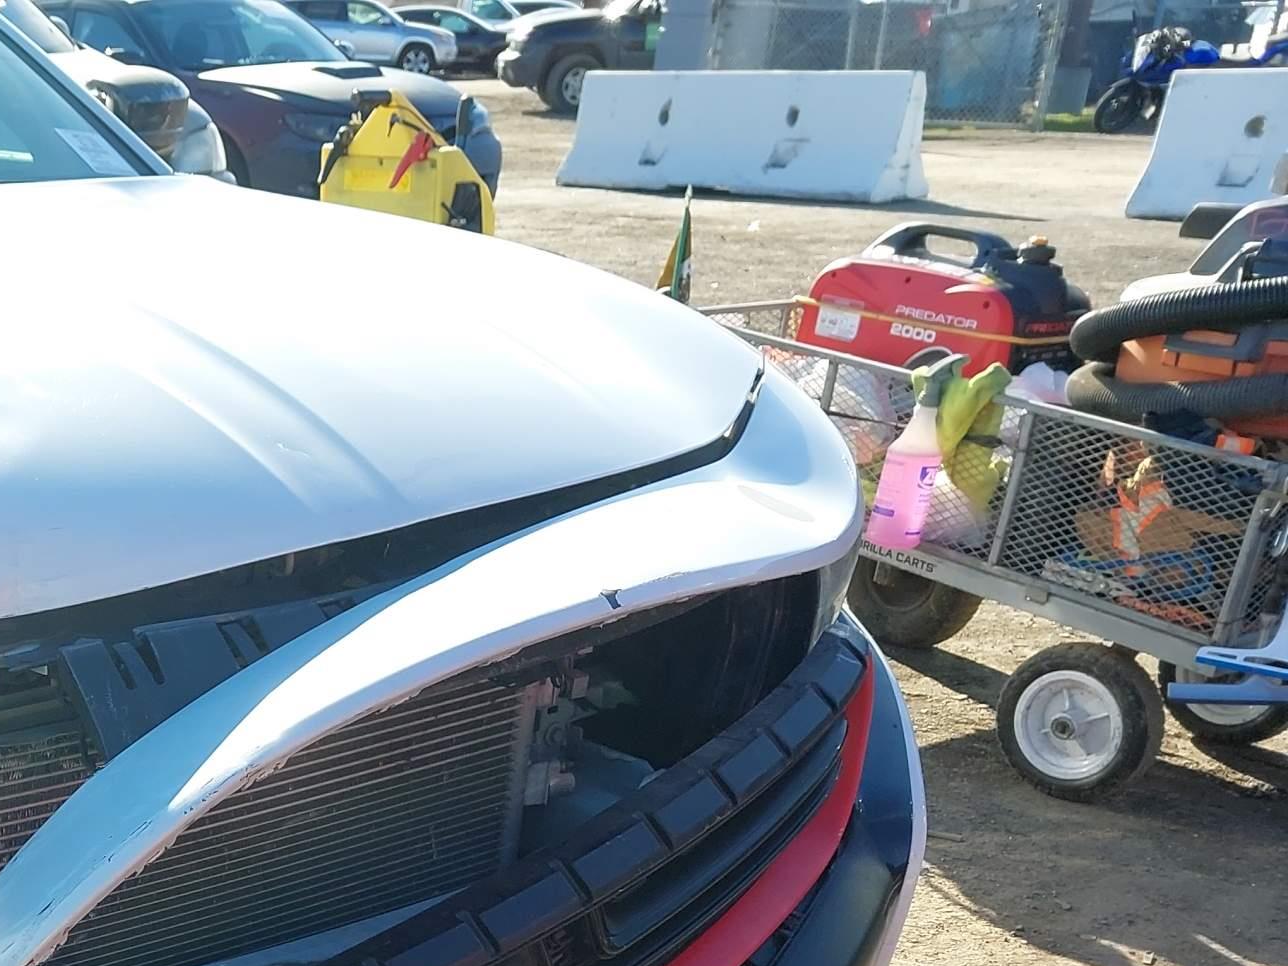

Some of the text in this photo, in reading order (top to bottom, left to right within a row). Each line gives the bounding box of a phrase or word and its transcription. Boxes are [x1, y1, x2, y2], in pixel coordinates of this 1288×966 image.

[895, 304, 978, 330] PREDATOR
[889, 322, 937, 343] 2000
[863, 539, 934, 573] RILLA CARTS
